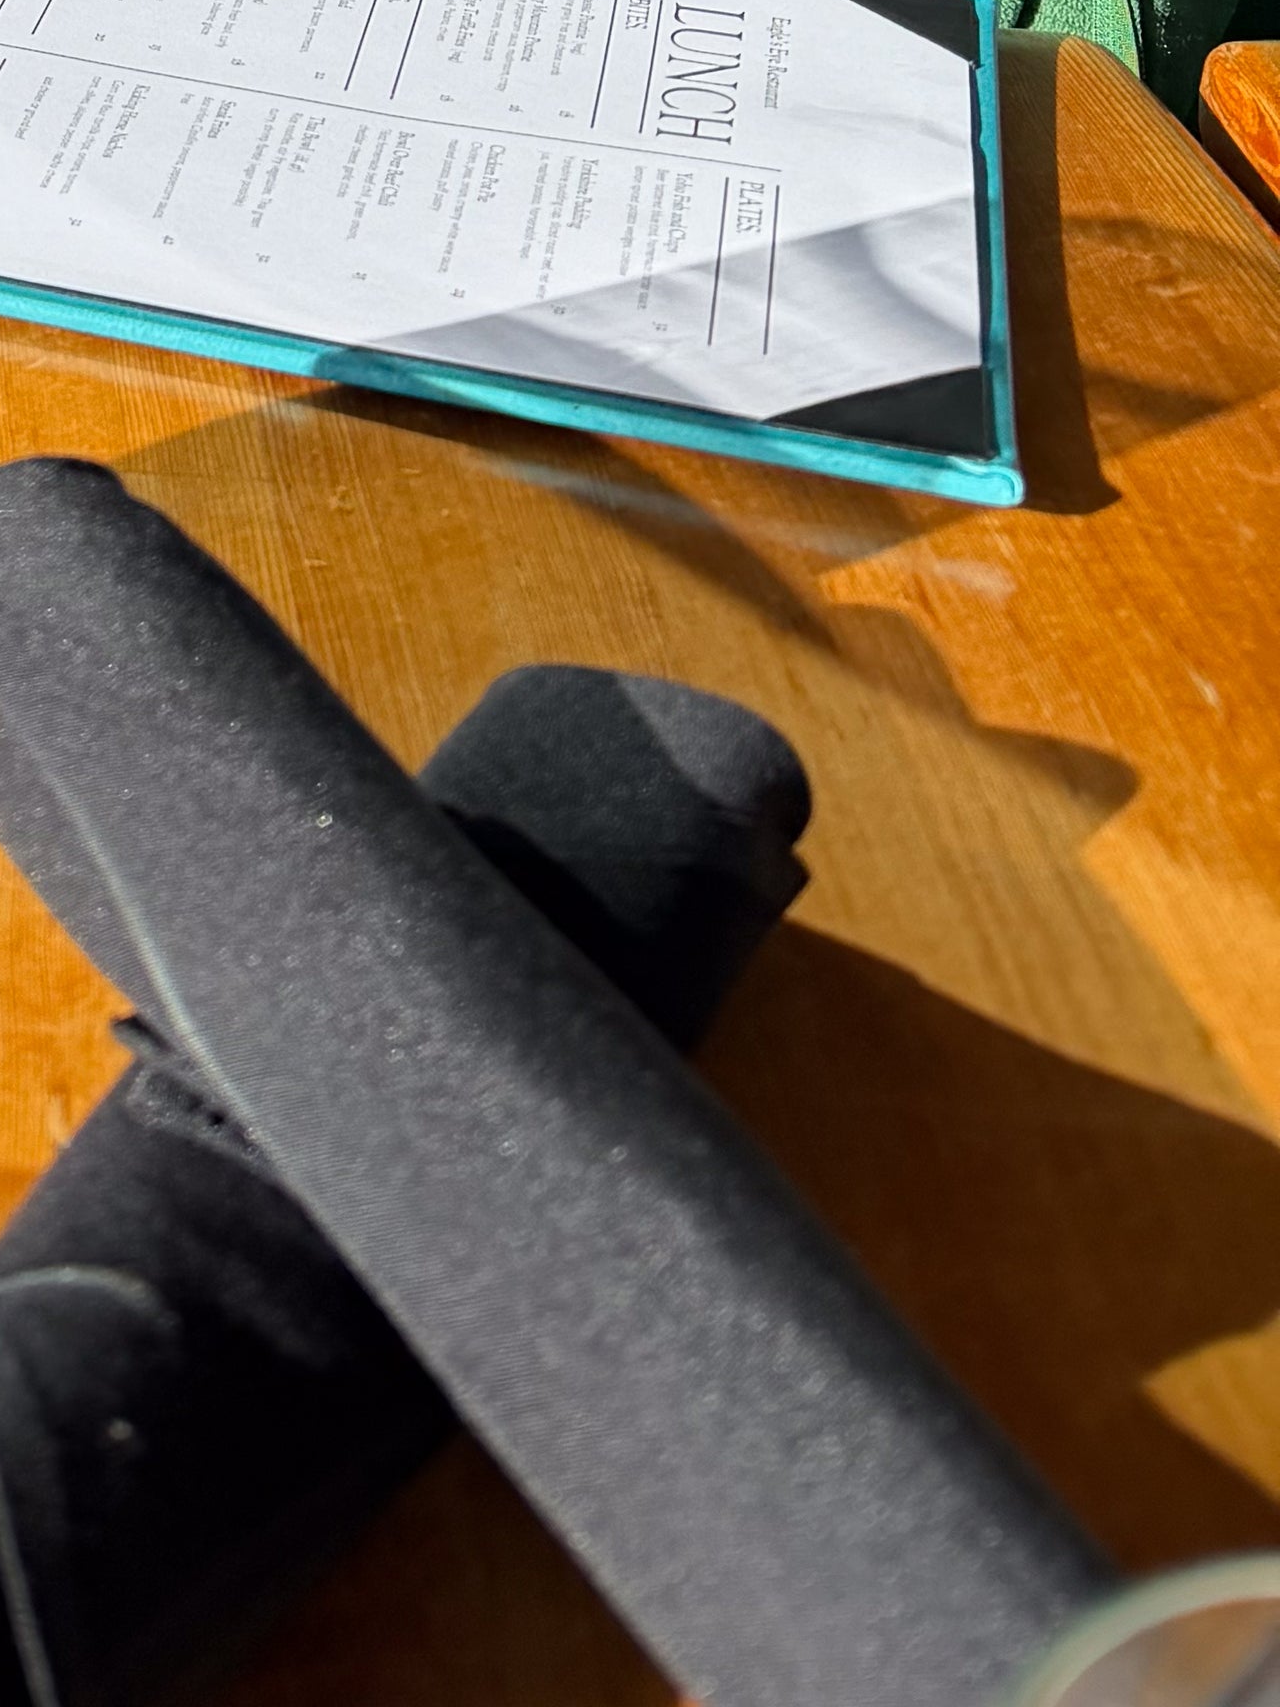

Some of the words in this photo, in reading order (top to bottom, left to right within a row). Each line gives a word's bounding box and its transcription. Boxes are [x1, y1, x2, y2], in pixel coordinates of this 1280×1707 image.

[766, 16, 790, 47] Eagle's
[656, 4, 744, 142] LUNCH
[764, 47, 788, 64] Eye
[736, 180, 764, 233] PLATES.
